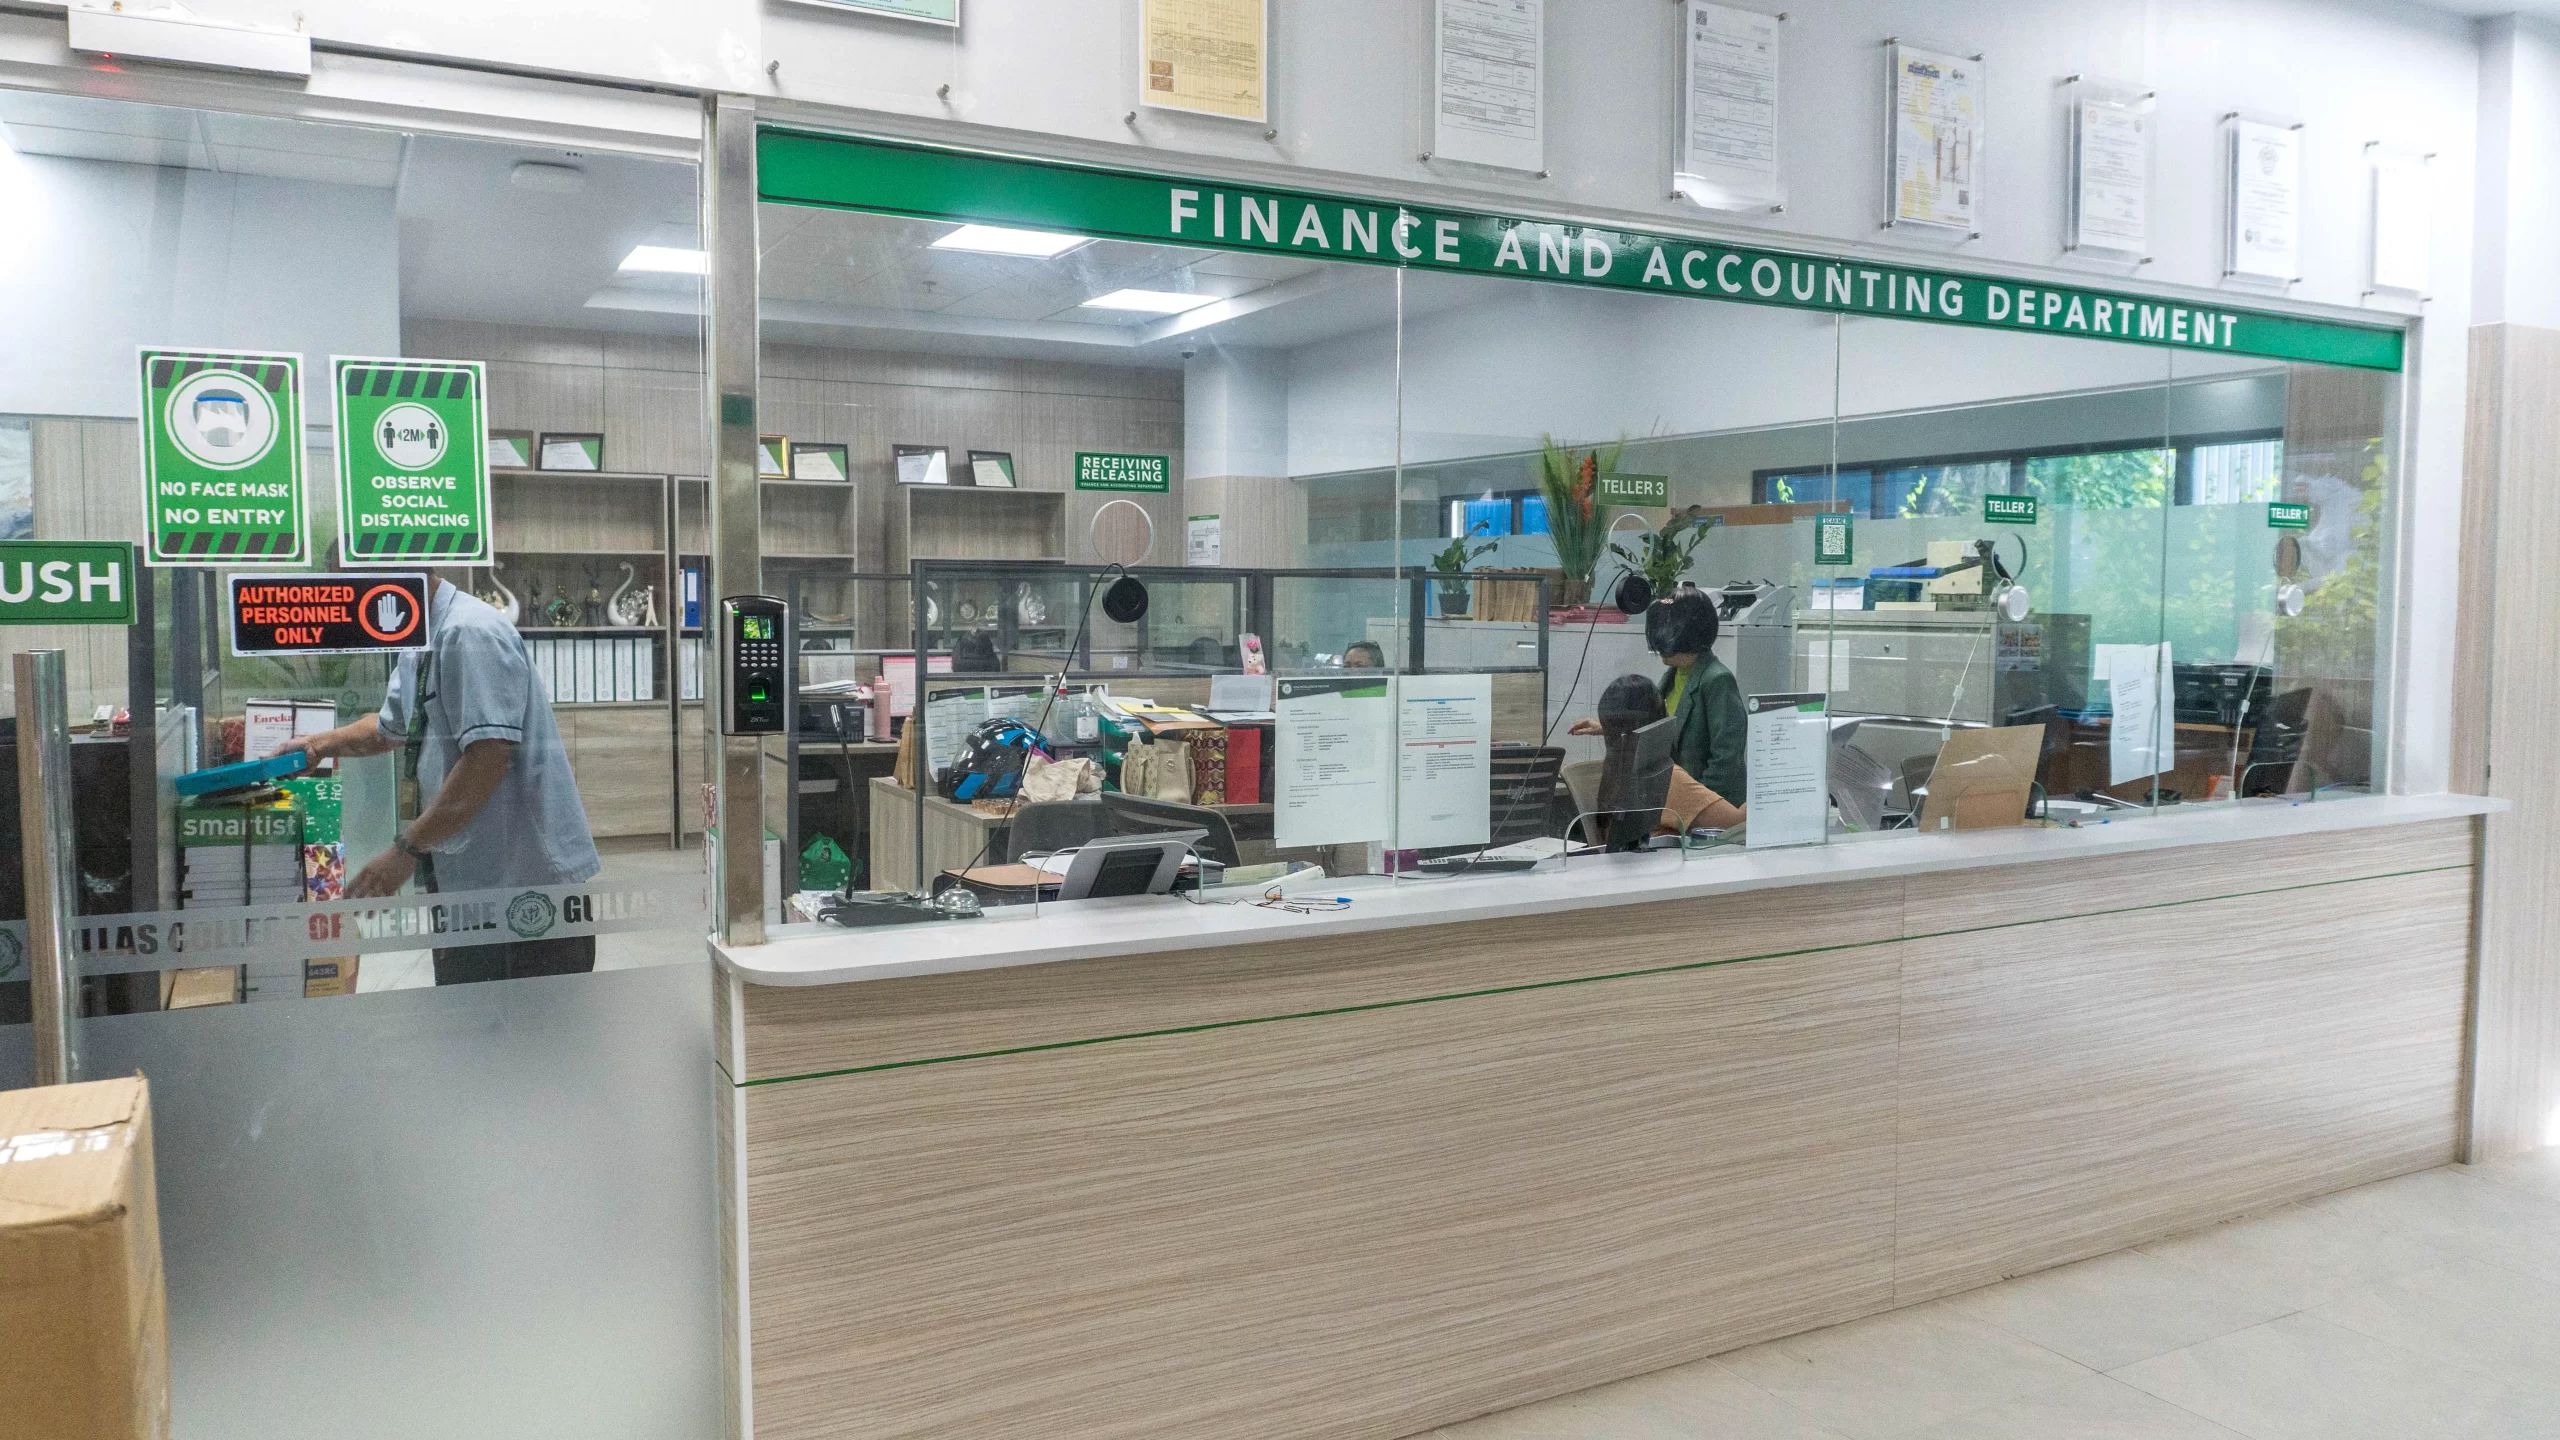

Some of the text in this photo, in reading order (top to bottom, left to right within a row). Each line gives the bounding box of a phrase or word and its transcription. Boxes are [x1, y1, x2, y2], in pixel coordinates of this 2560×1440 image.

[1171, 187, 2239, 347] FINANCE AND ACCOUNTING DEPARTMENT
[403, 428, 420, 442] 2M
[1082, 456, 1162, 471] RECEIVING
[371, 475, 457, 490] OBSERVE
[1081, 468, 1163, 482] RELEASING
[160, 481, 289, 498] NO FACE MASK
[1602, 479, 1665, 497] TELLER 3
[381, 494, 449, 509] SOCIAL
[1988, 500, 2034, 514] TELLER 2
[165, 508, 286, 525] NO ENTRY
[360, 513, 470, 527] DISTANCING
[2270, 507, 2308, 520] TELLER 1
[0, 561, 121, 603] USH
[238, 586, 355, 605] AUTHORIZED
[241, 605, 352, 625] PERSONNEL
[274, 627, 325, 645] ONLY
[183, 816, 296, 836] smartist
